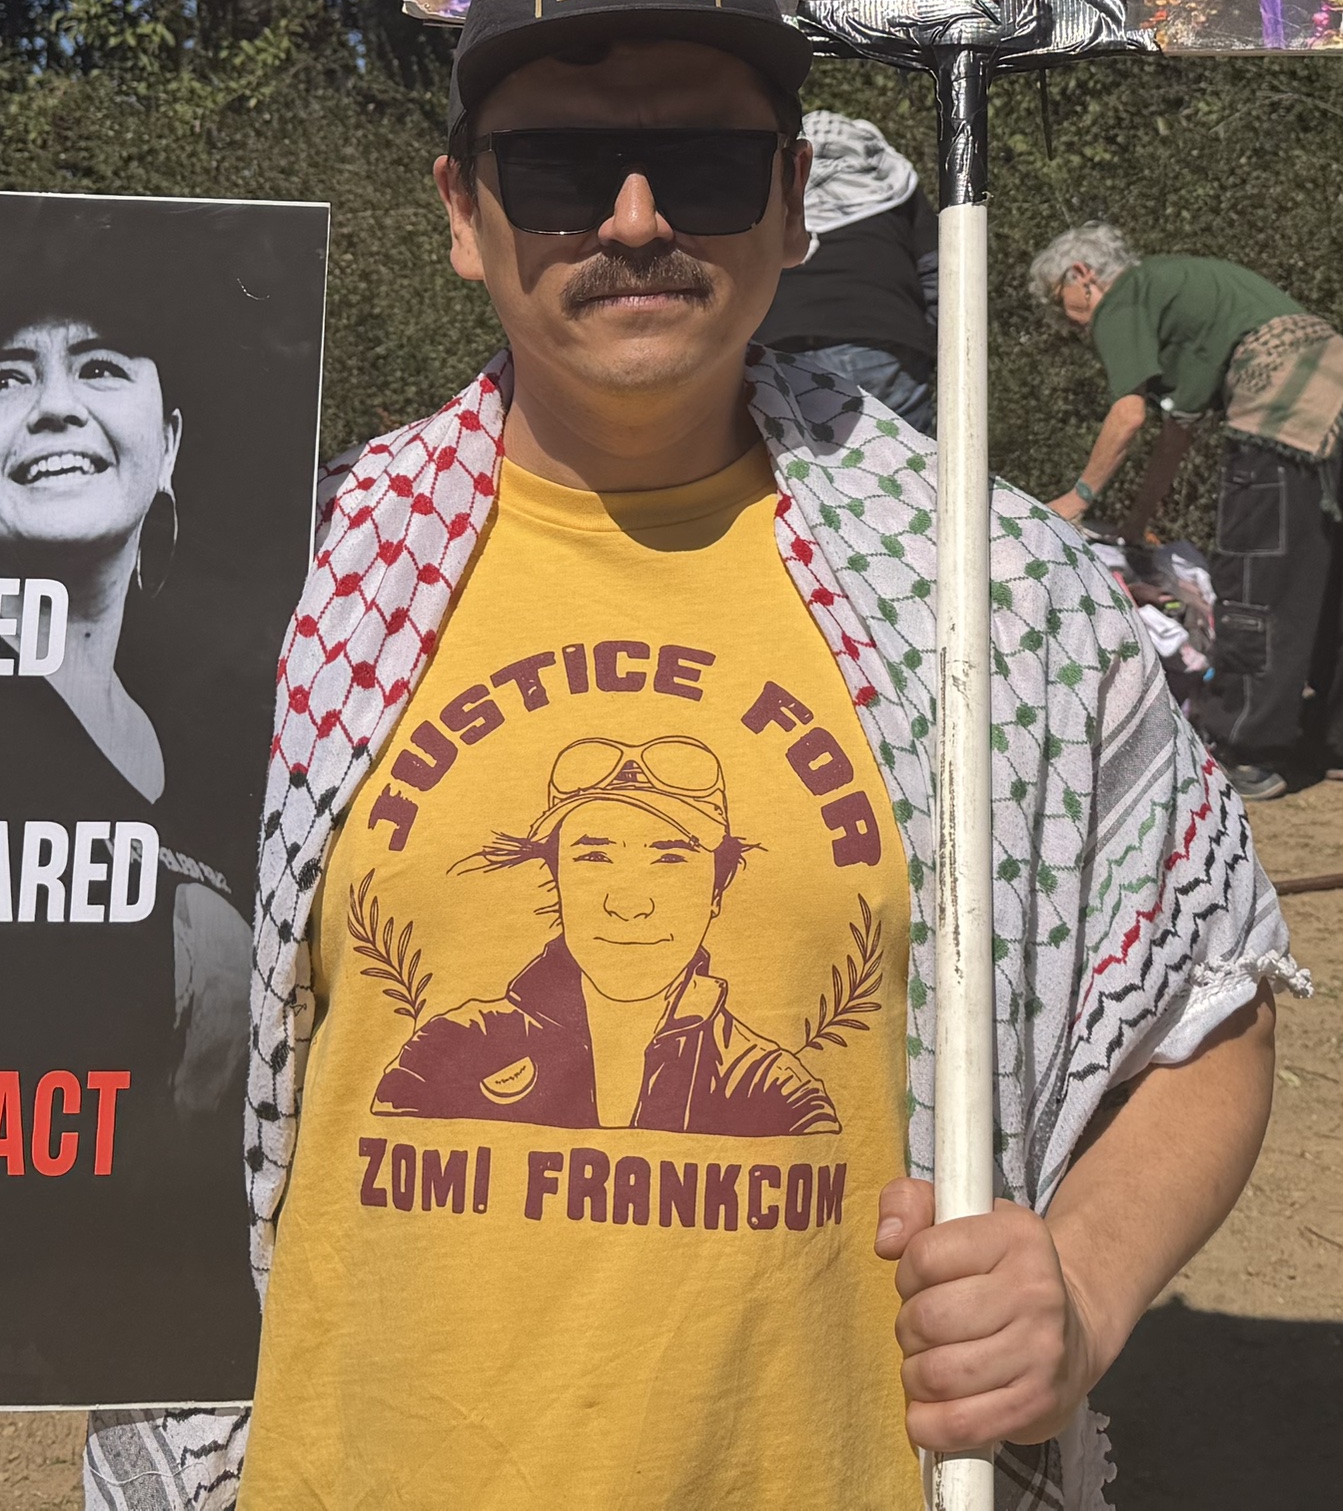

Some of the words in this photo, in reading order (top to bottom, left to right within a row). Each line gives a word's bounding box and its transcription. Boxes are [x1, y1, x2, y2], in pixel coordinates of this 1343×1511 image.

[367, 640, 716, 852] JUSTICE
[740, 680, 882, 868] FOR
[358, 1137, 492, 1215] ZOMI
[523, 1147, 848, 1232] FRANKCOM
